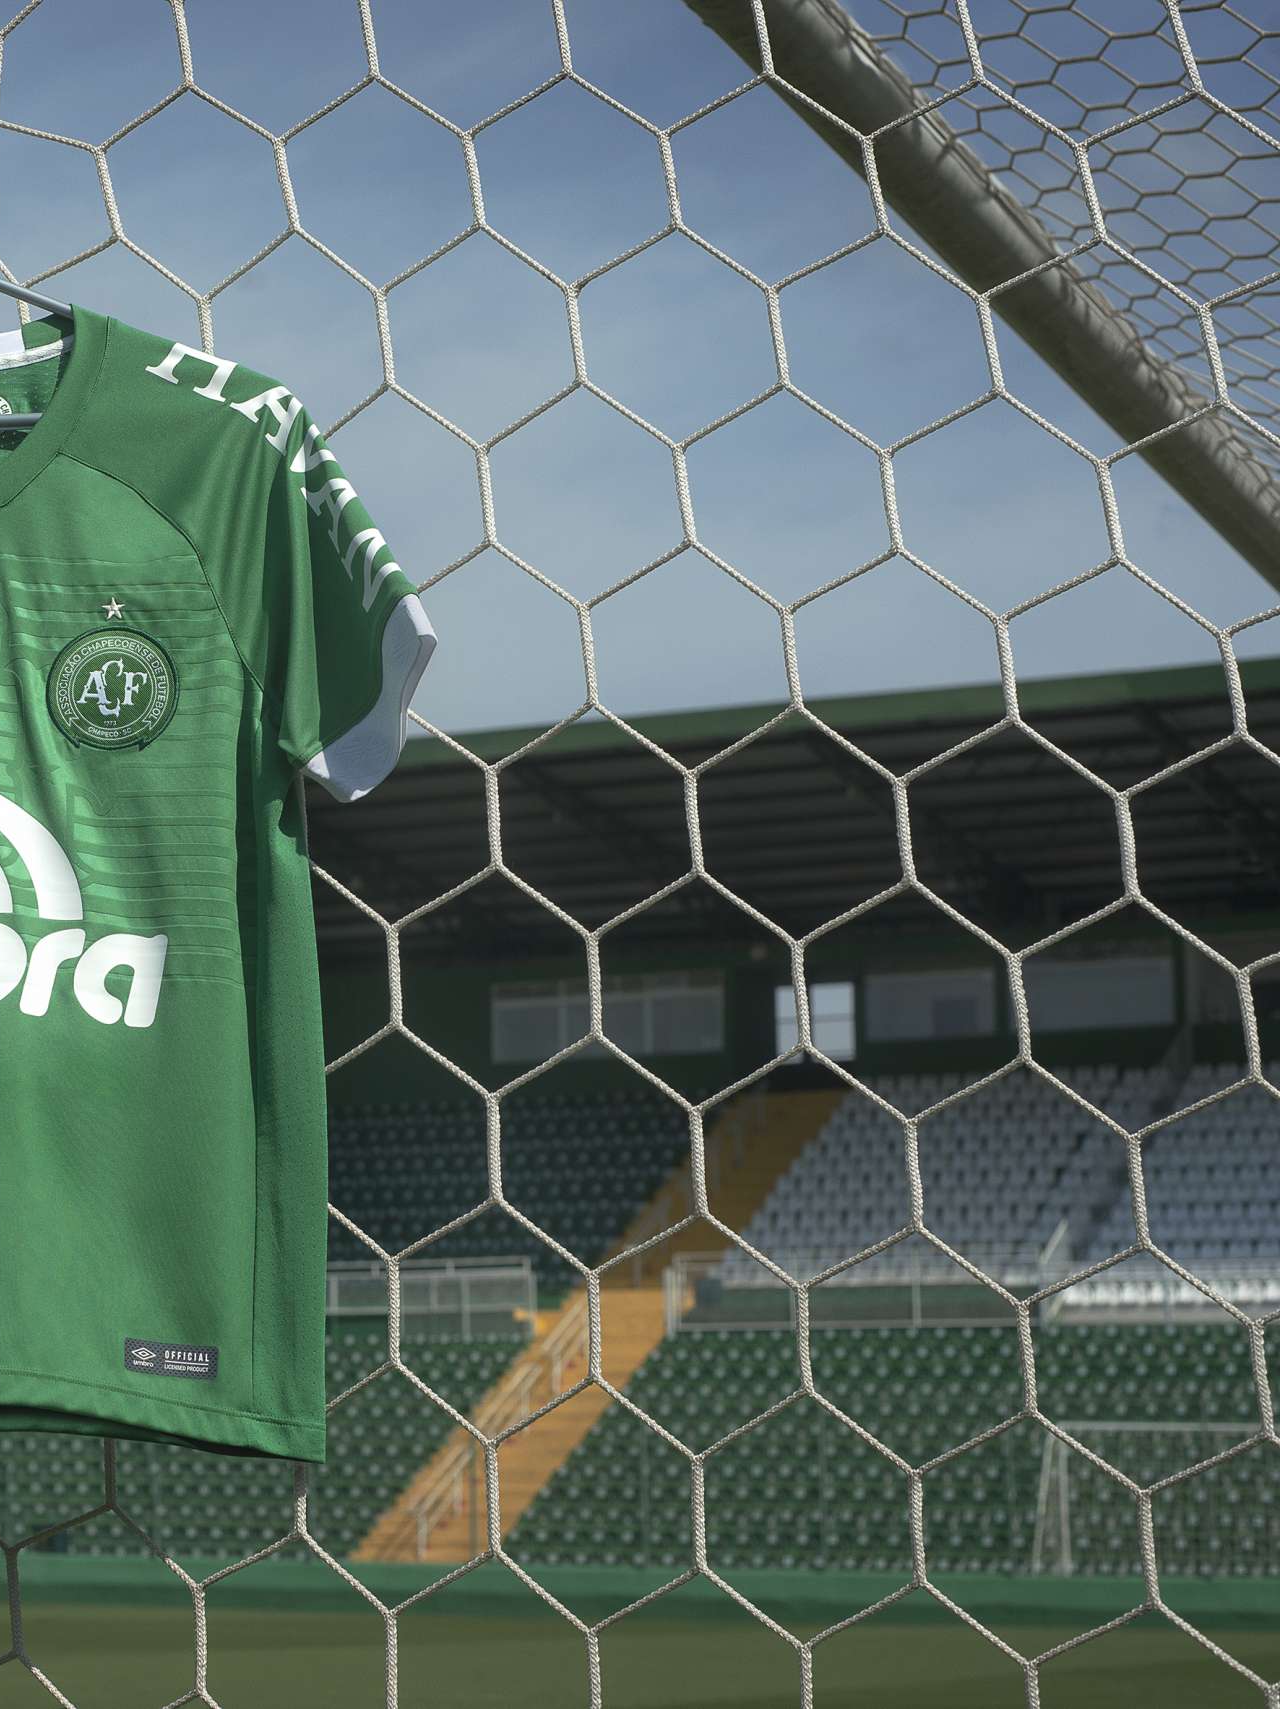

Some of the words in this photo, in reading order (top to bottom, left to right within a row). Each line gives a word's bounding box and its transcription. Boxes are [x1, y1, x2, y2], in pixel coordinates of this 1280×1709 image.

[81, 639, 154, 661] CHAPECOENSE
[151, 660, 163, 674] DE
[148, 675, 167, 720] FUTEBOL
[164, 1350, 210, 1362] OFFICIAL
